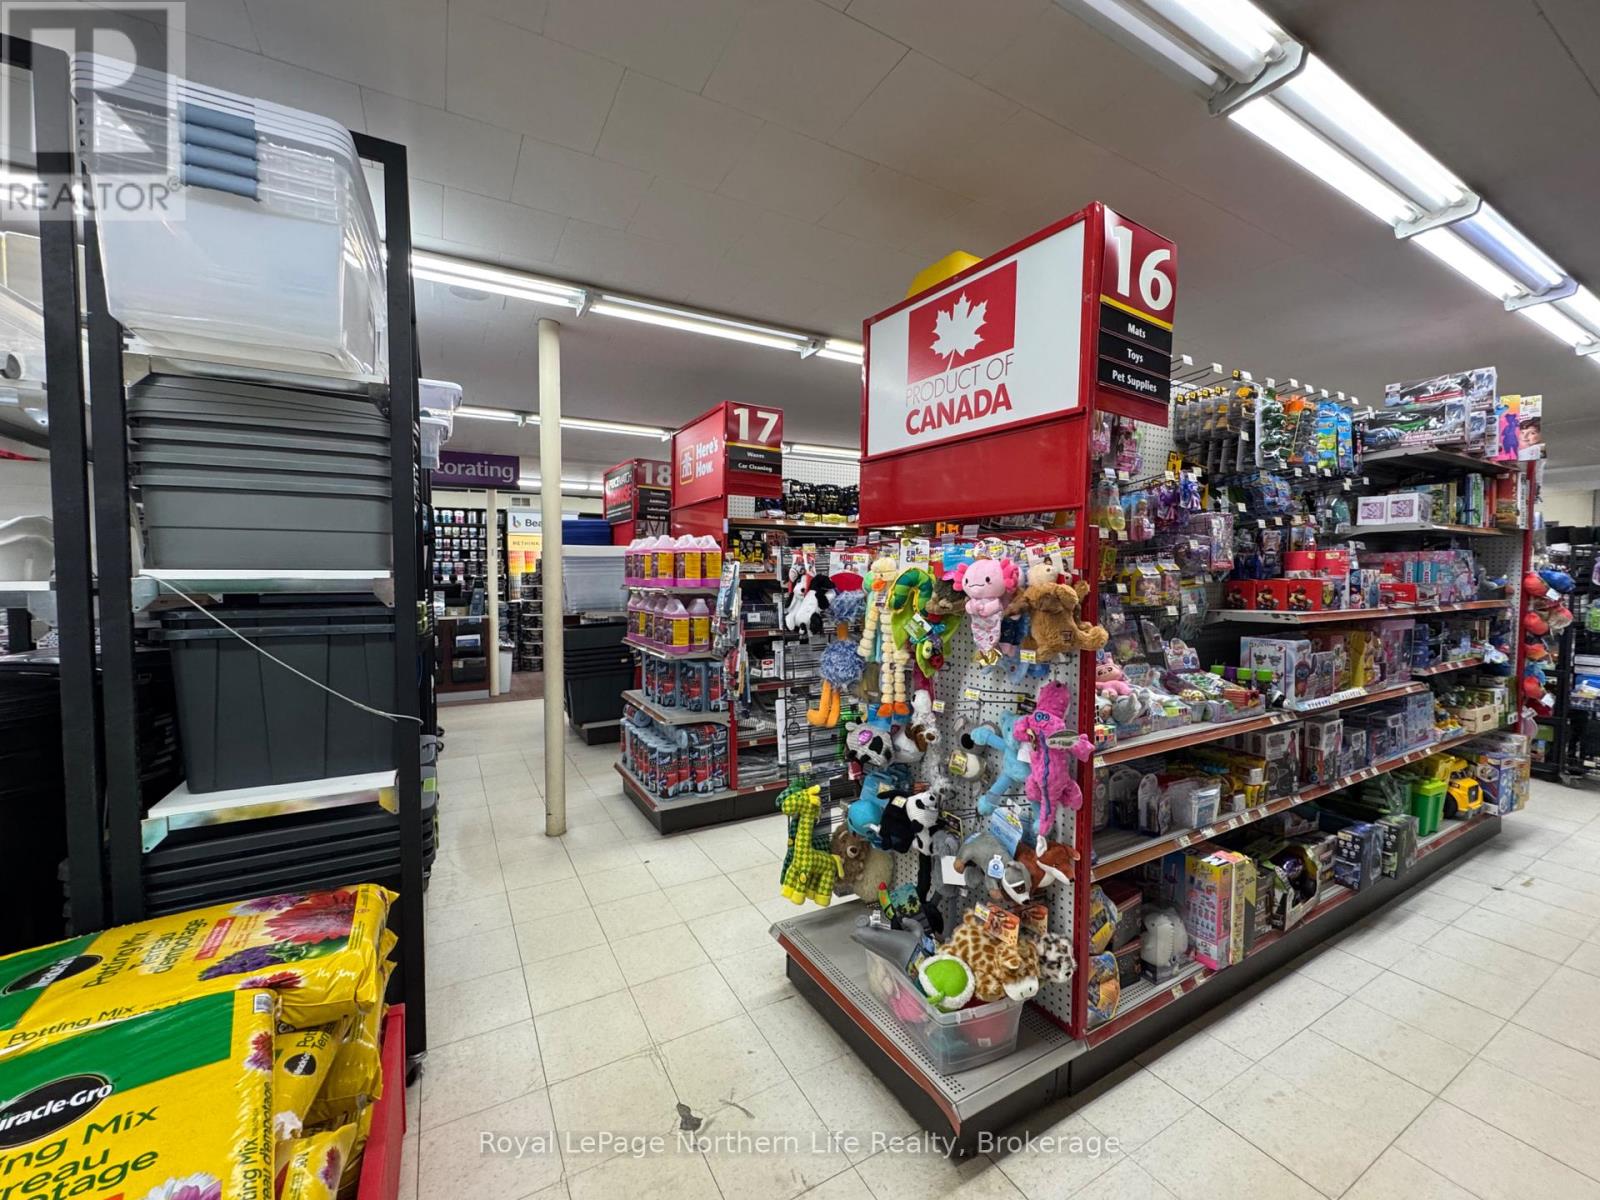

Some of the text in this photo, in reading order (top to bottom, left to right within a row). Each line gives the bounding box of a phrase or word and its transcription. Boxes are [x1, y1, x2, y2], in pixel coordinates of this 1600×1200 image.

[1112, 225, 1173, 311] 16
[1127, 322, 1146, 340] Mats
[1126, 347, 1144, 364] Toys
[905, 352, 1015, 407] PRODUCT OF
[1111, 369, 1158, 394] Pet Supplies
[905, 383, 1013, 435] CANADA
[733, 407, 779, 443] 17
[696, 436, 719, 460] Here's
[432, 461, 515, 483] corating
[641, 462, 672, 486] 18
[749, 463, 773, 473] Cleaning
[8, 1005, 135, 1045] Potting Mix
[83, 1105, 159, 1146] Mix
[239, 1137, 258, 1165] Mix
[0, 1149, 110, 1200] reau
